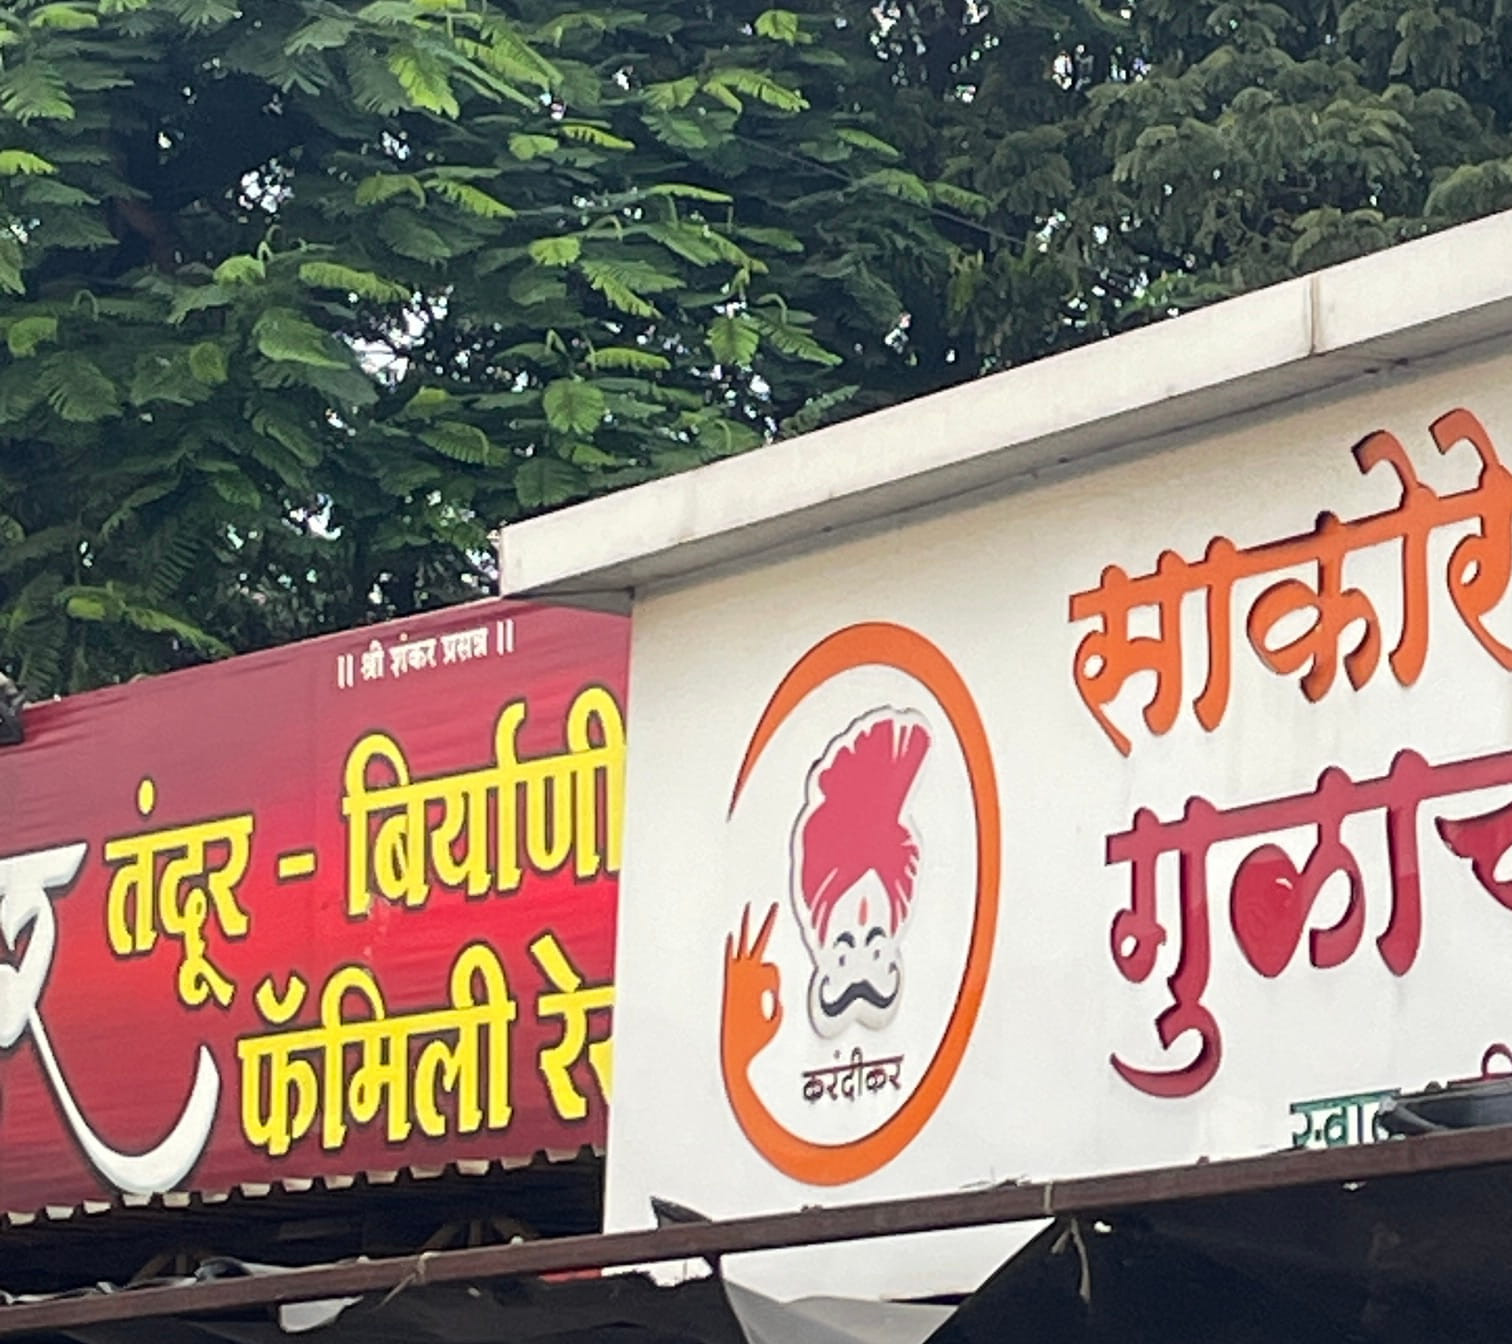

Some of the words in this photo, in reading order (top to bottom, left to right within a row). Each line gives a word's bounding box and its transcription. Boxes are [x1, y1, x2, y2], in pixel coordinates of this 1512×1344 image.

[361, 640, 384, 681] श्री
[389, 632, 437, 678] शंकर
[441, 627, 489, 664] प्रसन्न
[105, 778, 254, 1007] तंदूर
[342, 686, 625, 918] बिर्याणी
[238, 942, 516, 1155] फॅमिली
[802, 1046, 905, 1104] करंदीकर
